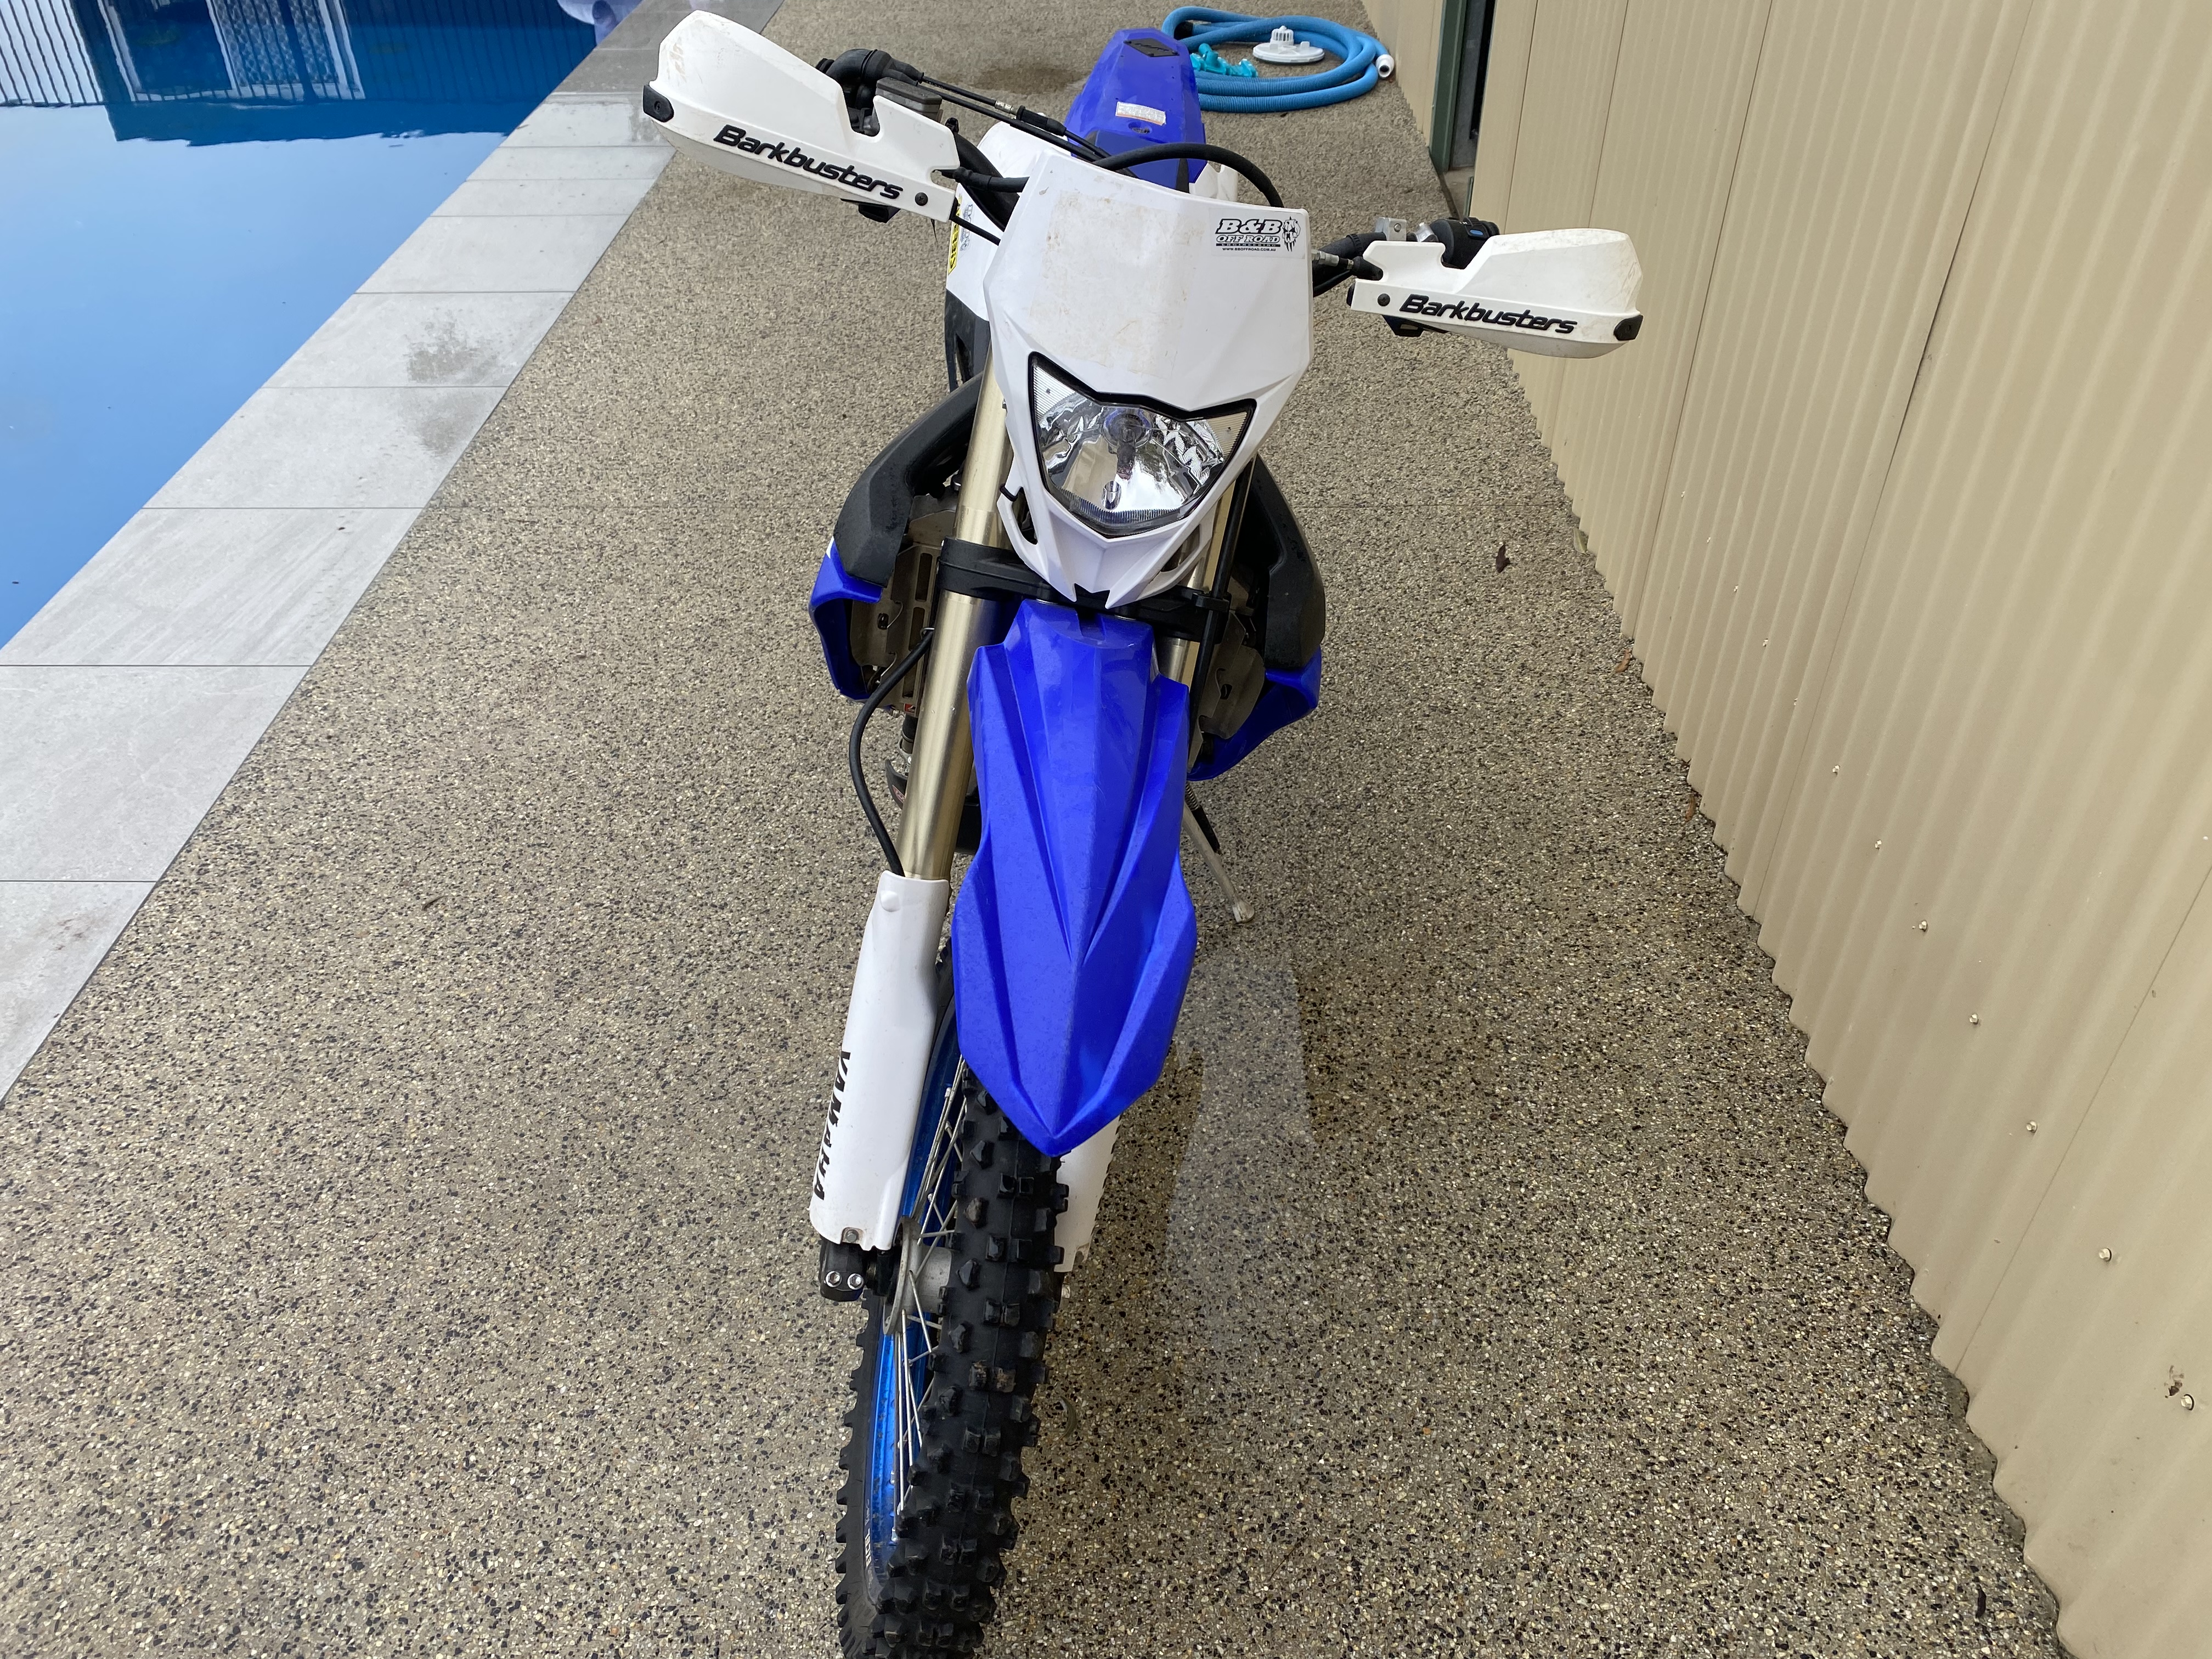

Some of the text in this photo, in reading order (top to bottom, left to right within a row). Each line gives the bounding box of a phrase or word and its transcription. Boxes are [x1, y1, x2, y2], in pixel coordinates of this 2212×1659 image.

[713, 124, 904, 199] Barkbusters
[1215, 218, 1283, 234] B&B
[1244, 235, 1280, 243] ROAD
[1399, 294, 1577, 334] Barkbusters
